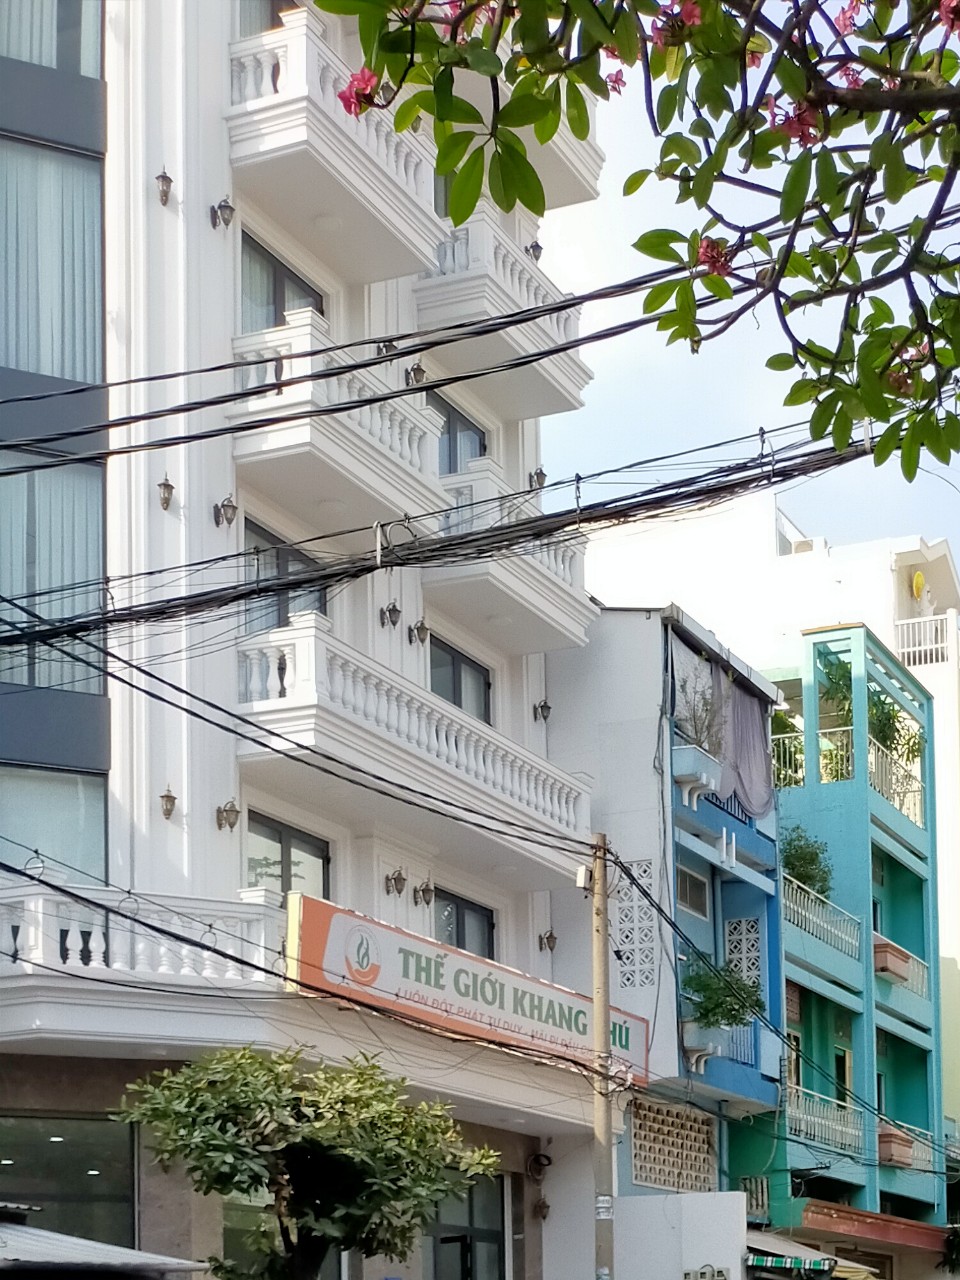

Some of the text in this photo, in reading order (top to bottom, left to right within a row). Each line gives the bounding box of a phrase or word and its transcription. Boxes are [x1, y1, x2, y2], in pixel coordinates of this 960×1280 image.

[398, 947, 630, 1051] THẾ GIỚI KHANG HÚ
